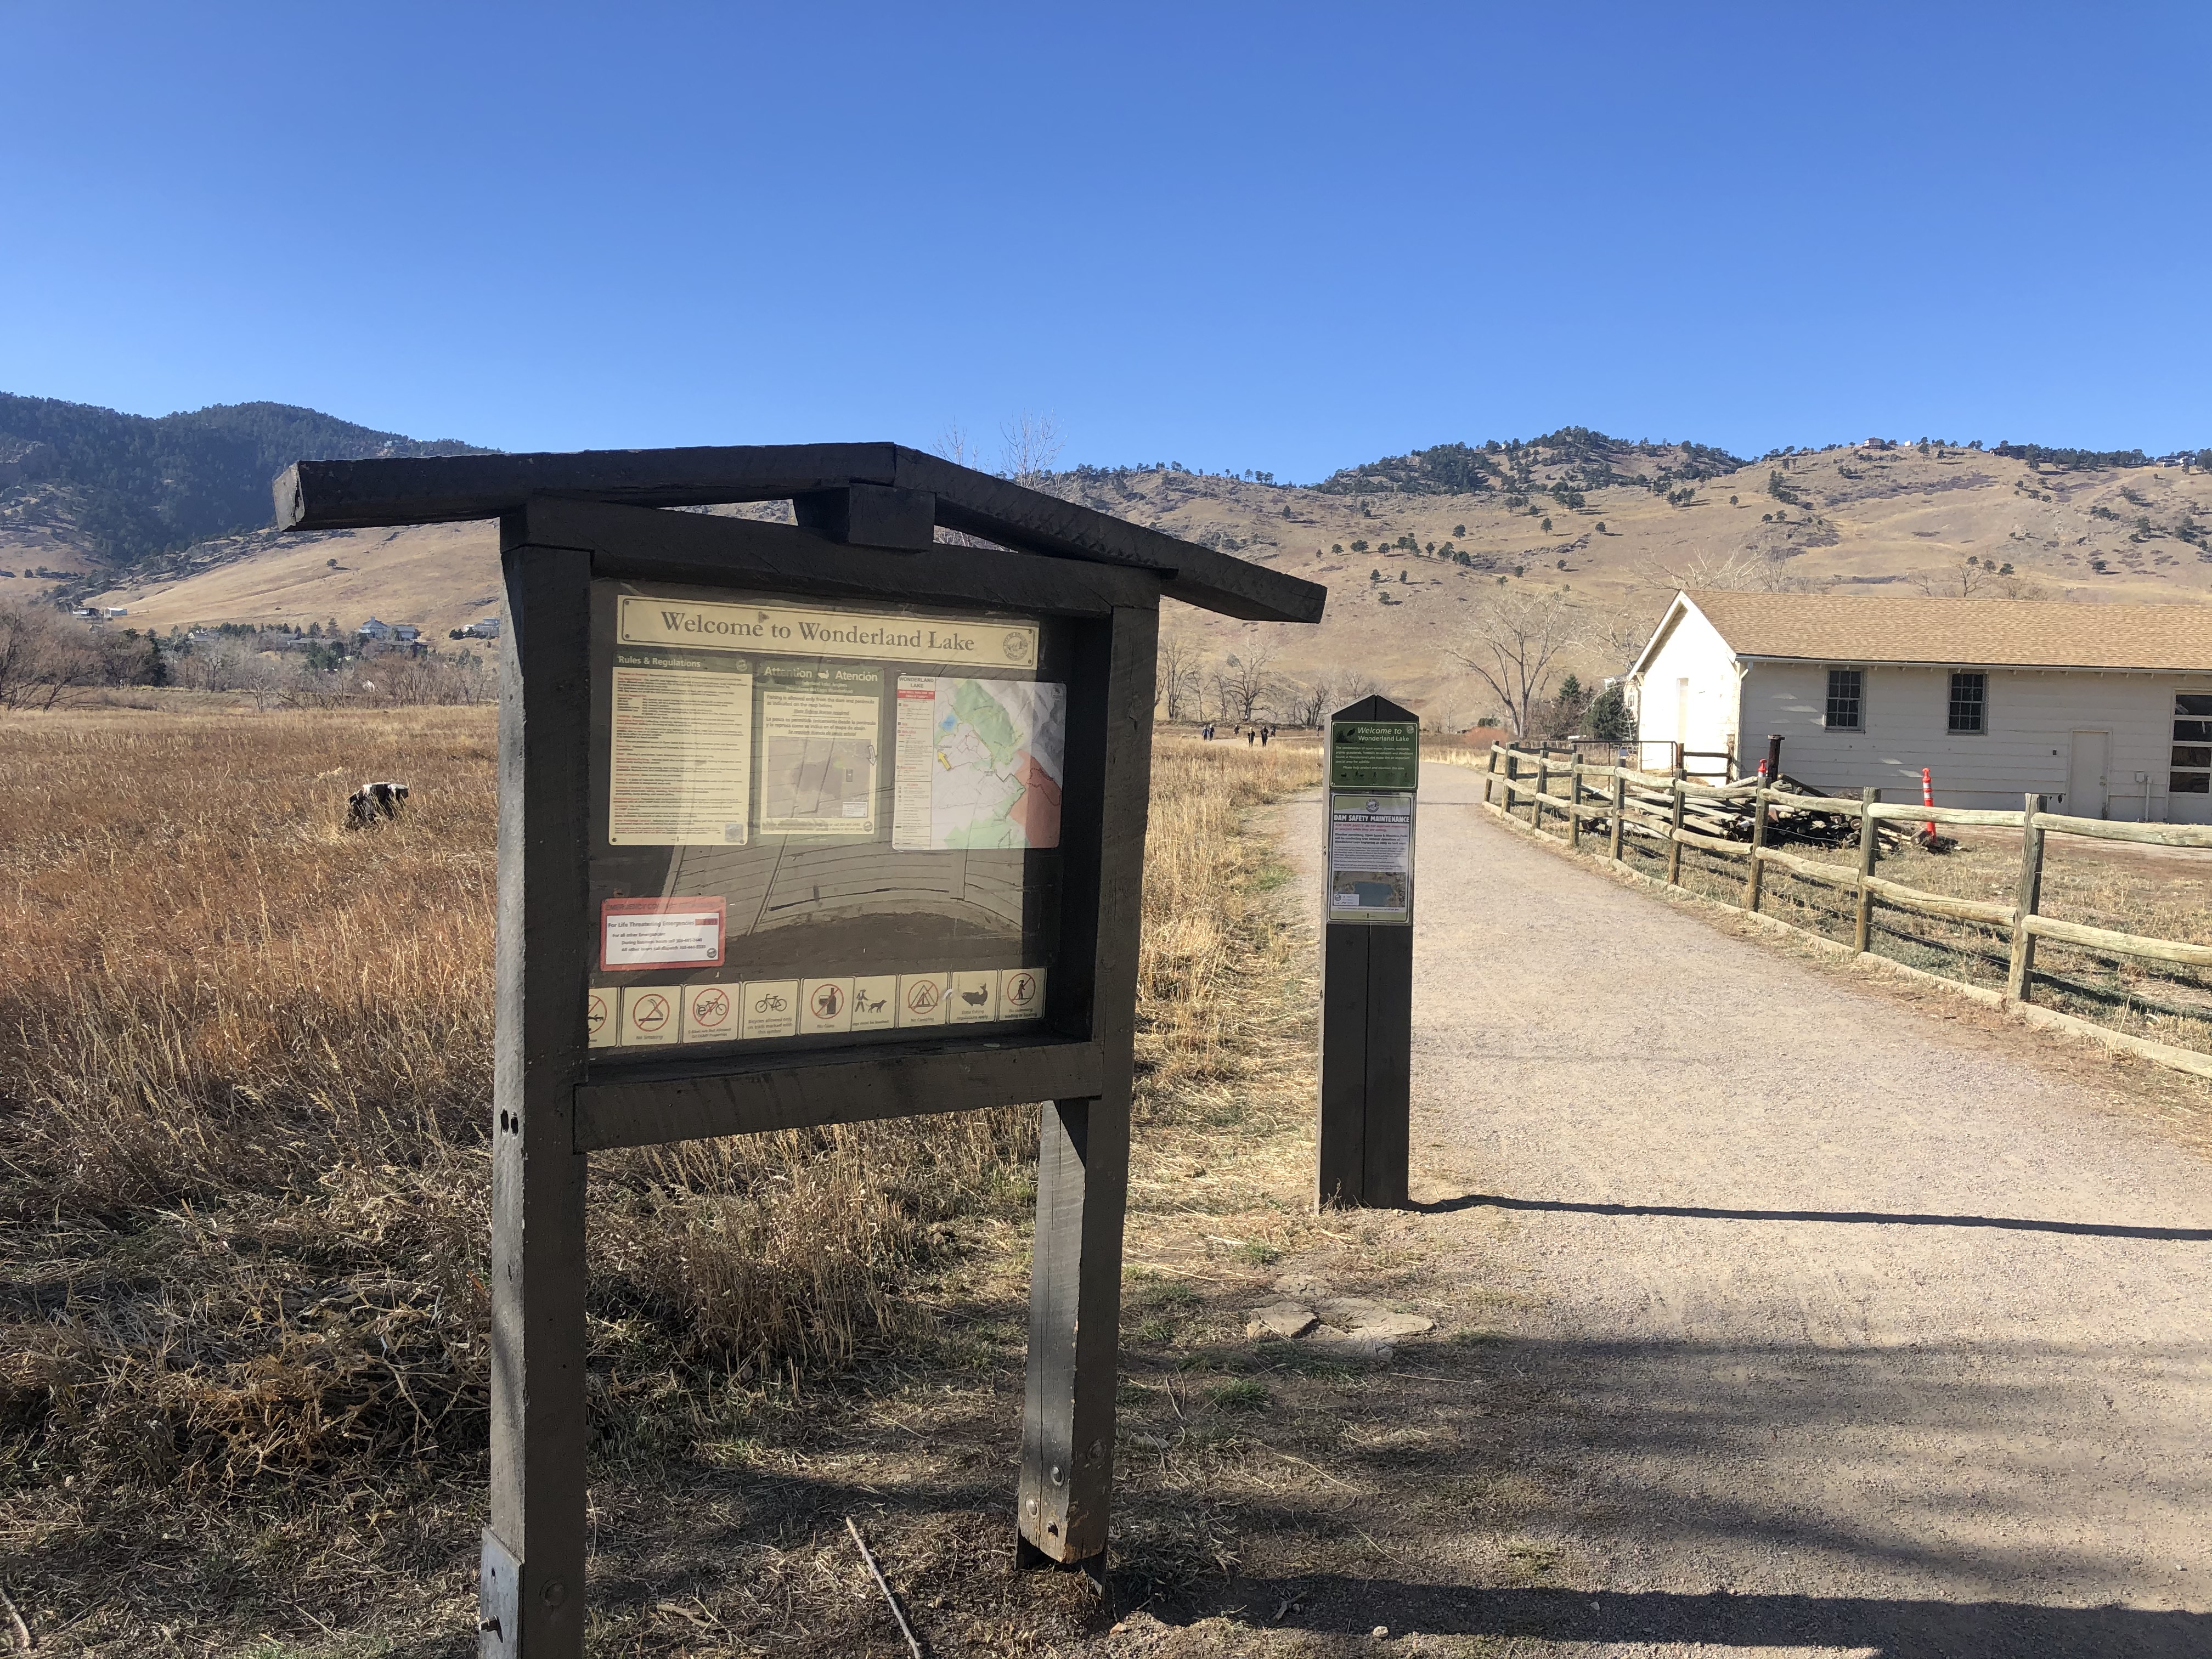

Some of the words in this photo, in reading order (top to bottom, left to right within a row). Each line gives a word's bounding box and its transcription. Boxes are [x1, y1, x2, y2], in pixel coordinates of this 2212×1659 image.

[661, 611, 764, 637] Welcome
[771, 618, 791, 639] to
[798, 620, 921, 647] Wonderland
[929, 629, 974, 651] Lake
[652, 659, 701, 668] Regulations
[764, 667, 812, 678] Attention
[835, 670, 877, 681] Atención
